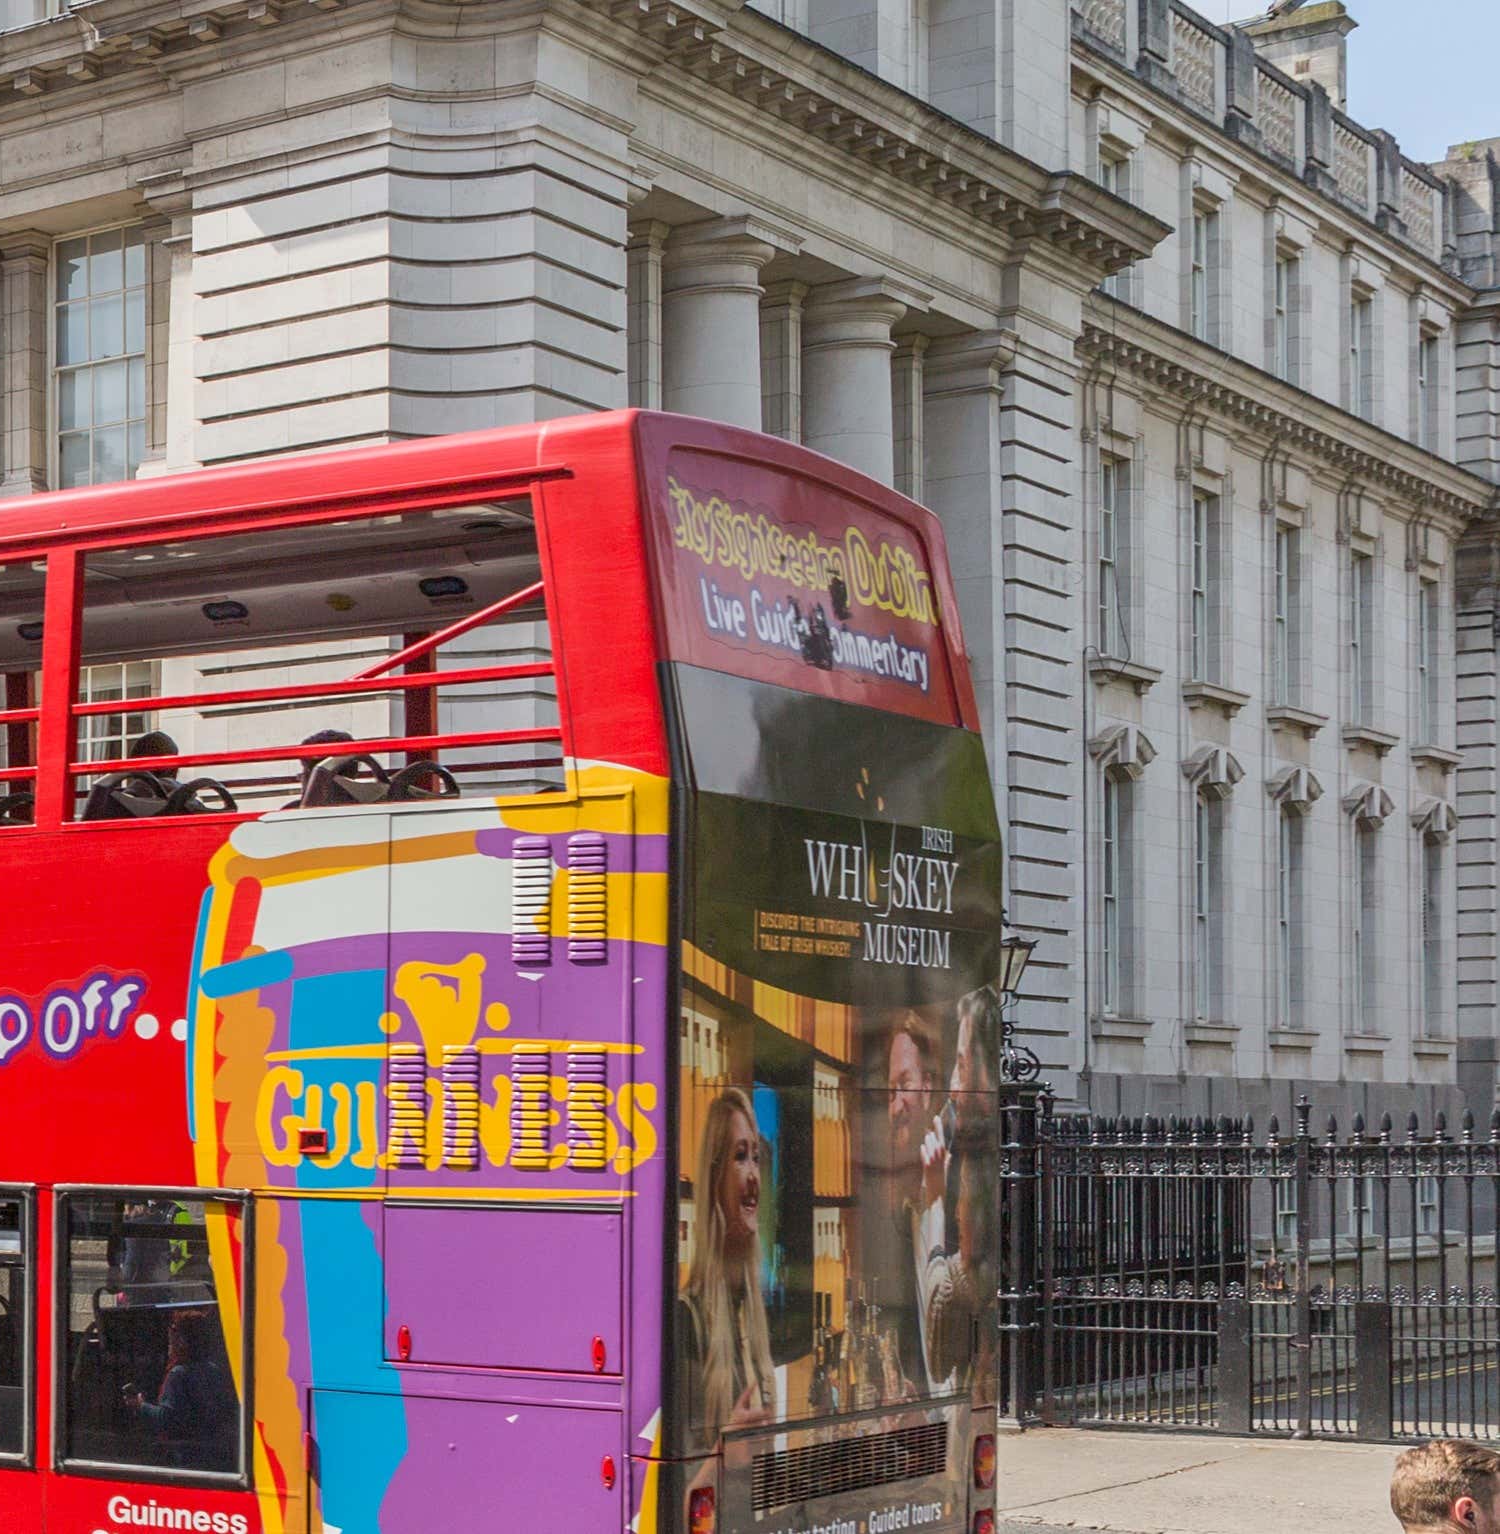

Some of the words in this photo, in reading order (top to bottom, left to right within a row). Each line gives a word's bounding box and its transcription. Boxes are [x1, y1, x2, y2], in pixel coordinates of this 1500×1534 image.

[700, 577, 747, 638] Live
[824, 626, 928, 691] ommentary
[921, 825, 954, 854] IRISH
[800, 915, 815, 933] THE
[862, 921, 951, 968] MUSEUM
[42, 978, 141, 1055] Off
[107, 1495, 248, 1534] Guinness
[868, 1503, 910, 1534] Guided
[912, 1502, 942, 1525] tours
